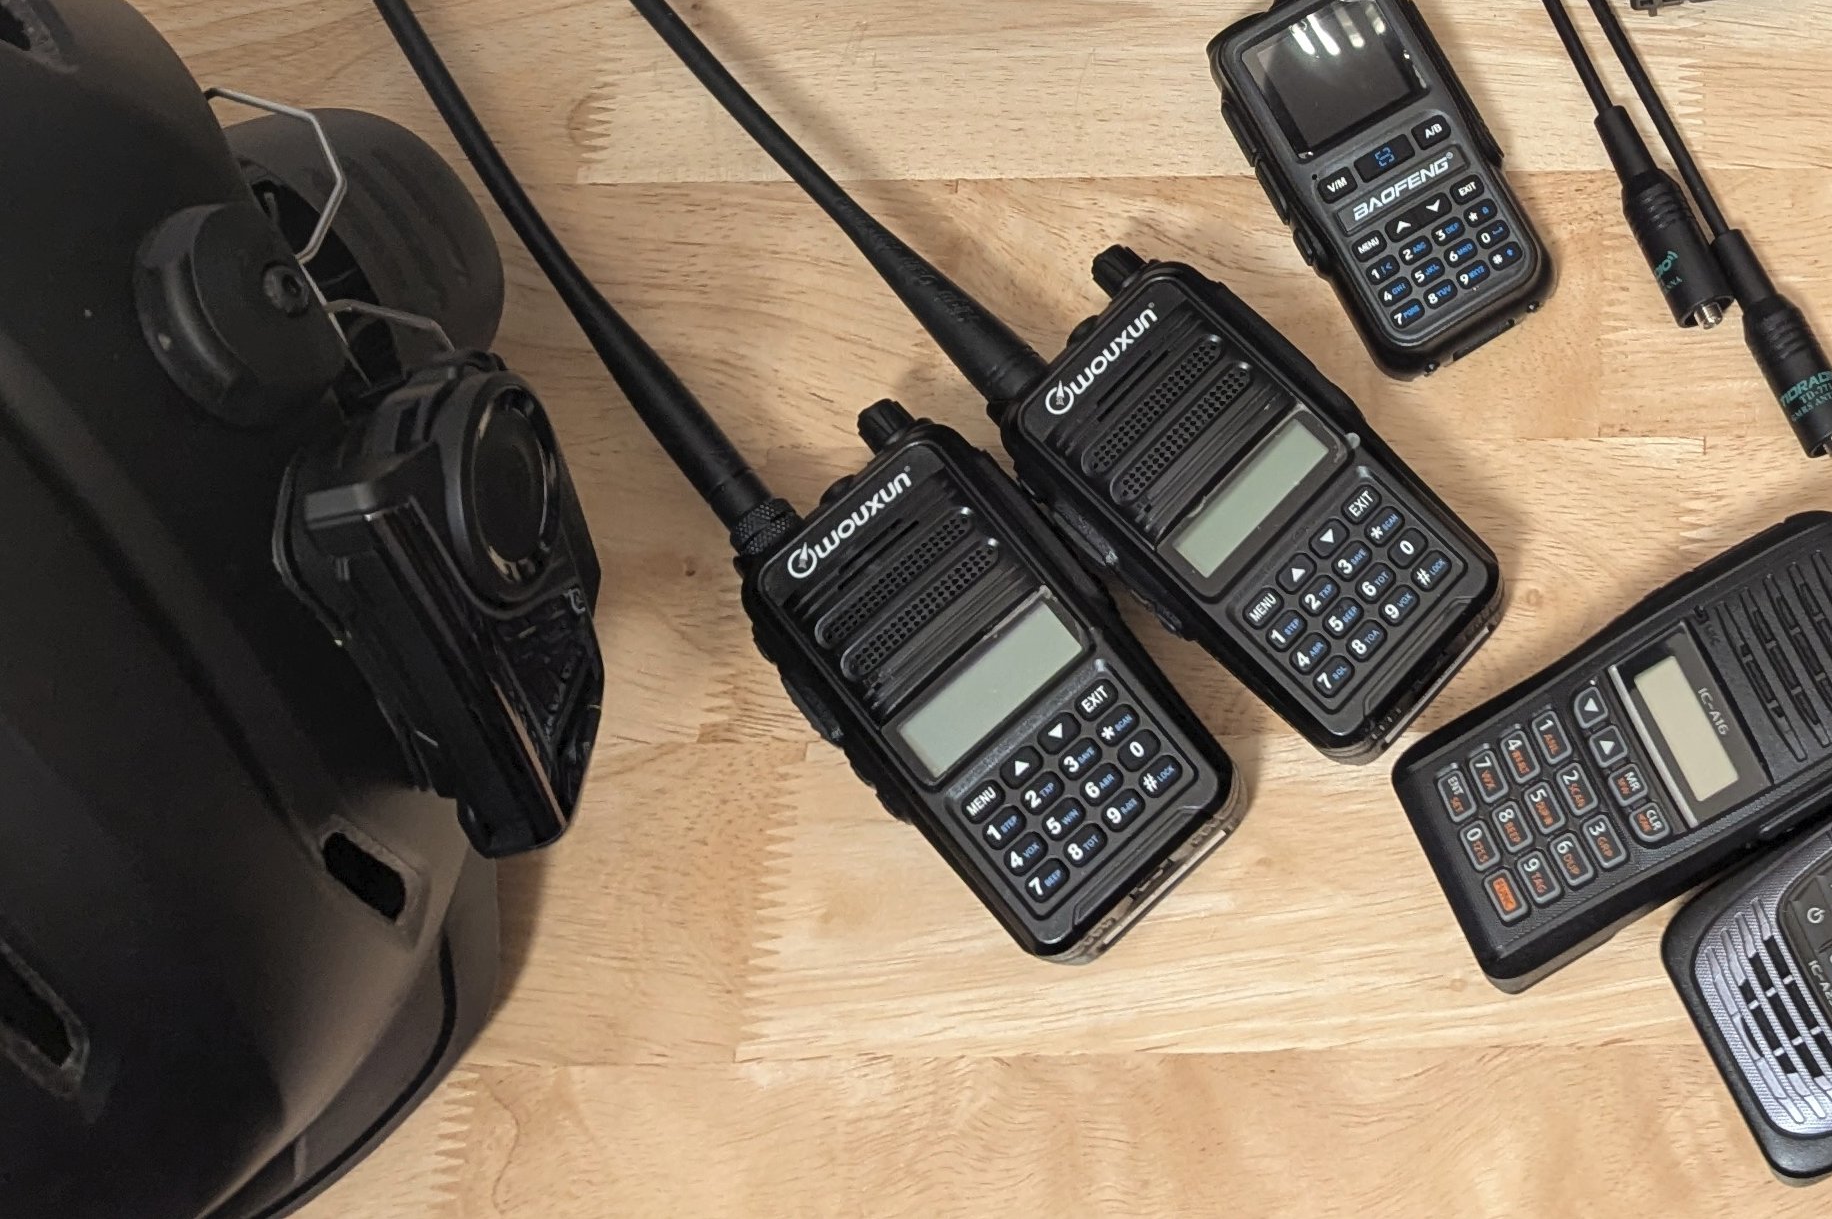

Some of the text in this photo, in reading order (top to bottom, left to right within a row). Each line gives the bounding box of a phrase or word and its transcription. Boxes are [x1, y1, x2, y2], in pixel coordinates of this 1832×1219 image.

[1327, 124, 1442, 192] V/M A/B
[1353, 157, 1450, 221] BAOFENG
[1358, 182, 1476, 254] MENU EXIT
[1371, 269, 1380, 279] 1
[1403, 249, 1413, 260] 2
[1436, 230, 1446, 241] 3
[1383, 291, 1392, 301] 4
[1414, 271, 1425, 282] 5
[1449, 251, 1458, 262] 6
[1481, 233, 1491, 244] 0
[1394, 313, 1402, 324] 7
[1428, 293, 1438, 304] 8
[1459, 274, 1469, 284] 9
[1070, 308, 1158, 395] wouxun
[1799, 382, 1832, 403] TD-771
[814, 472, 912, 558] wouxun
[1249, 490, 1373, 622] MENU EXIT
[1271, 629, 1285, 643] 1
[1284, 618, 1301, 635] STEP
[1305, 593, 1321, 610] 2
[1337, 559, 1353, 574] 3
[1350, 549, 1366, 565] SAVE
[1381, 514, 1399, 531] SCAN
[1296, 651, 1310, 667] 4
[1329, 615, 1344, 632] 5
[1361, 582, 1377, 596] 6
[1400, 540, 1415, 555] 0
[1317, 672, 1332, 689] 7
[1351, 639, 1367, 654] 8
[1384, 603, 1399, 619] 9
[1416, 568, 1431, 586] #
[1429, 558, 1446, 575] LOCK
[966, 686, 1108, 816] MENU EXIT
[1696, 687, 1728, 737] IC-A16
[987, 825, 1001, 840] 1
[1000, 816, 1018, 833] STEP
[1025, 790, 1042, 808] 2
[1063, 756, 1080, 772] 3
[1077, 747, 1095, 765] SAVE
[1114, 714, 1133, 732] SCAN
[1010, 851, 1024, 868] 4
[1046, 817, 1062, 835] 5
[1084, 782, 1100, 798] 6
[1129, 741, 1145, 757] 0
[1447, 775, 1465, 795] ENT
[1466, 827, 1482, 842] 0
[1475, 756, 1491, 768] 7
[1498, 808, 1515, 822] 8
[1523, 858, 1539, 872] 9
[1507, 739, 1522, 751] 4
[1530, 789, 1547, 803] 5
[1556, 840, 1573, 854] 6
[1539, 719, 1554, 731] 1
[1562, 769, 1579, 785] 2
[1588, 821, 1605, 836] 3
[1624, 771, 1662, 831] MR CLR
[1028, 877, 1042, 895] 7
[1067, 843, 1083, 860] 8
[1082, 834, 1099, 851] TOT
[1106, 807, 1122, 824] 9
[1143, 773, 1158, 792] #
[1156, 765, 1175, 783] LOCK
